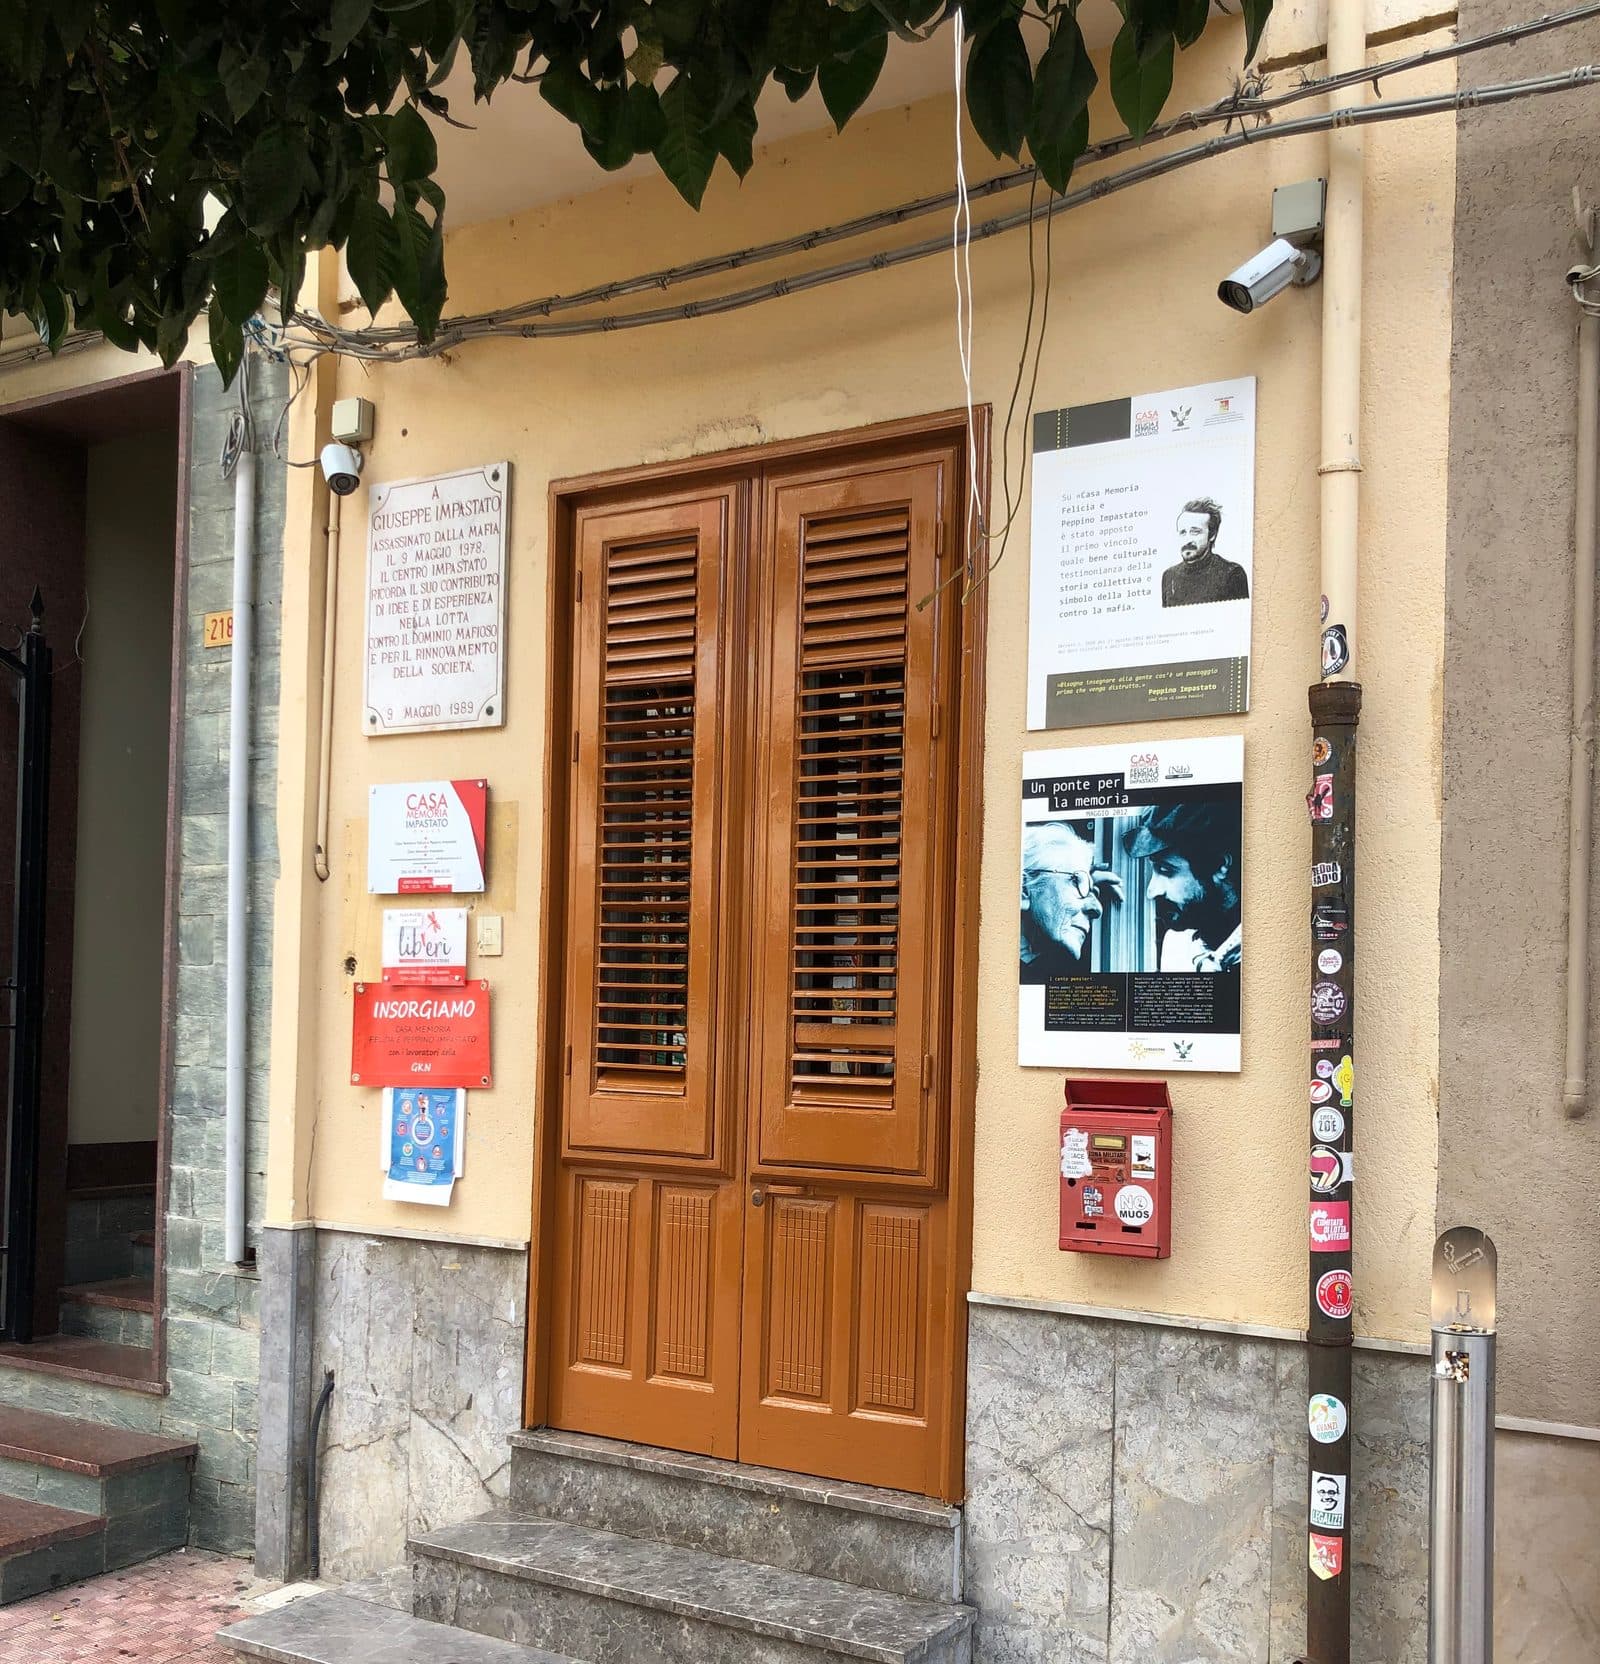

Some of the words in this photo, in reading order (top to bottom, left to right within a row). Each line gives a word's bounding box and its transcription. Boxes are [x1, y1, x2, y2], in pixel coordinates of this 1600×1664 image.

[432, 485, 439, 499] A
[1105, 484, 1139, 495] Memoria
[373, 507, 431, 531] GIUSEPPE
[436, 496, 501, 521] IMPASTATO
[1062, 504, 1095, 514] Felicia
[1061, 517, 1095, 528] Peppino
[374, 533, 431, 552] ASSASSINATO
[435, 528, 464, 543] DALLA
[469, 522, 500, 537] MAFIA
[1071, 530, 1094, 539] stato
[1099, 525, 1134, 536] apposto
[1074, 543, 1099, 552] primo
[1104, 537, 1138, 548] vincolo
[386, 554, 395, 567] IL
[401, 553, 408, 564] 9
[415, 546, 451, 562] MAGGIO
[460, 541, 485, 556] 1978.
[1060, 557, 1084, 567] quale
[1089, 554, 1108, 563] bene
[1113, 547, 1158, 560] culturale
[381, 571, 389, 583] IL
[392, 565, 428, 582] CENTRO
[432, 557, 487, 577] IMPASTATO
[1060, 566, 1122, 579] testimonianza
[1127, 561, 1152, 571] della
[371, 586, 407, 600] RICORDA
[410, 583, 418, 595] IL
[421, 581, 438, 594] SUO
[440, 573, 499, 592] CONTRIBUTO
[1060, 582, 1088, 592] storia
[1093, 577, 1142, 588] collettiva
[376, 604, 384, 616] DI
[388, 601, 409, 615] IDEE
[413, 600, 419, 612] E
[422, 598, 431, 611] DI
[434, 592, 493, 610] ESPERIENZA
[1059, 594, 1093, 606] simbolo
[1097, 591, 1122, 601] della
[1127, 588, 1151, 597] lotta
[1059, 609, 1088, 618] contro
[1092, 606, 1102, 614] la
[1106, 603, 1135, 613] mafia.
[211, 616, 233, 640] 218
[399, 616, 431, 630] NELLA
[436, 611, 469, 626] LOTTA
[369, 634, 400, 649] CONTRO
[402, 633, 410, 645] IL
[412, 629, 452, 644] DOMINIO
[456, 624, 497, 641] MAFIOSO
[371, 653, 377, 665] E
[381, 651, 400, 664] PER
[402, 650, 411, 662] IL
[416, 641, 497, 661] RINNOVAMENTO
[393, 665, 423, 679] DELLA
[1148, 686, 1177, 695] Peppino
[1180, 684, 1217, 693] Impastato
[386, 708, 393, 720] 9
[404, 704, 441, 719] MAGGIO
[450, 701, 474, 715] 1989
[1130, 754, 1159, 764] CASA
[1031, 781, 1045, 793] Un
[1053, 779, 1090, 795] ponte
[1098, 778, 1120, 792] per
[406, 793, 448, 810] CASA
[1054, 796, 1068, 808] la
[1075, 793, 1129, 807] memoria
[406, 809, 448, 819] MEMORIA
[405, 818, 448, 829] IMPASTATO
[373, 1000, 475, 1020] INSORGIAMO
[395, 1025, 412, 1033] CASA
[415, 1025, 451, 1033] MEMORIA
[406, 1048, 439, 1056] lavoratori
[411, 1062, 432, 1072] GKN
[1119, 1194, 1148, 1211] NO
[1119, 1210, 1149, 1219] MUOS
[1312, 1511, 1342, 1527] LEGALIZE
